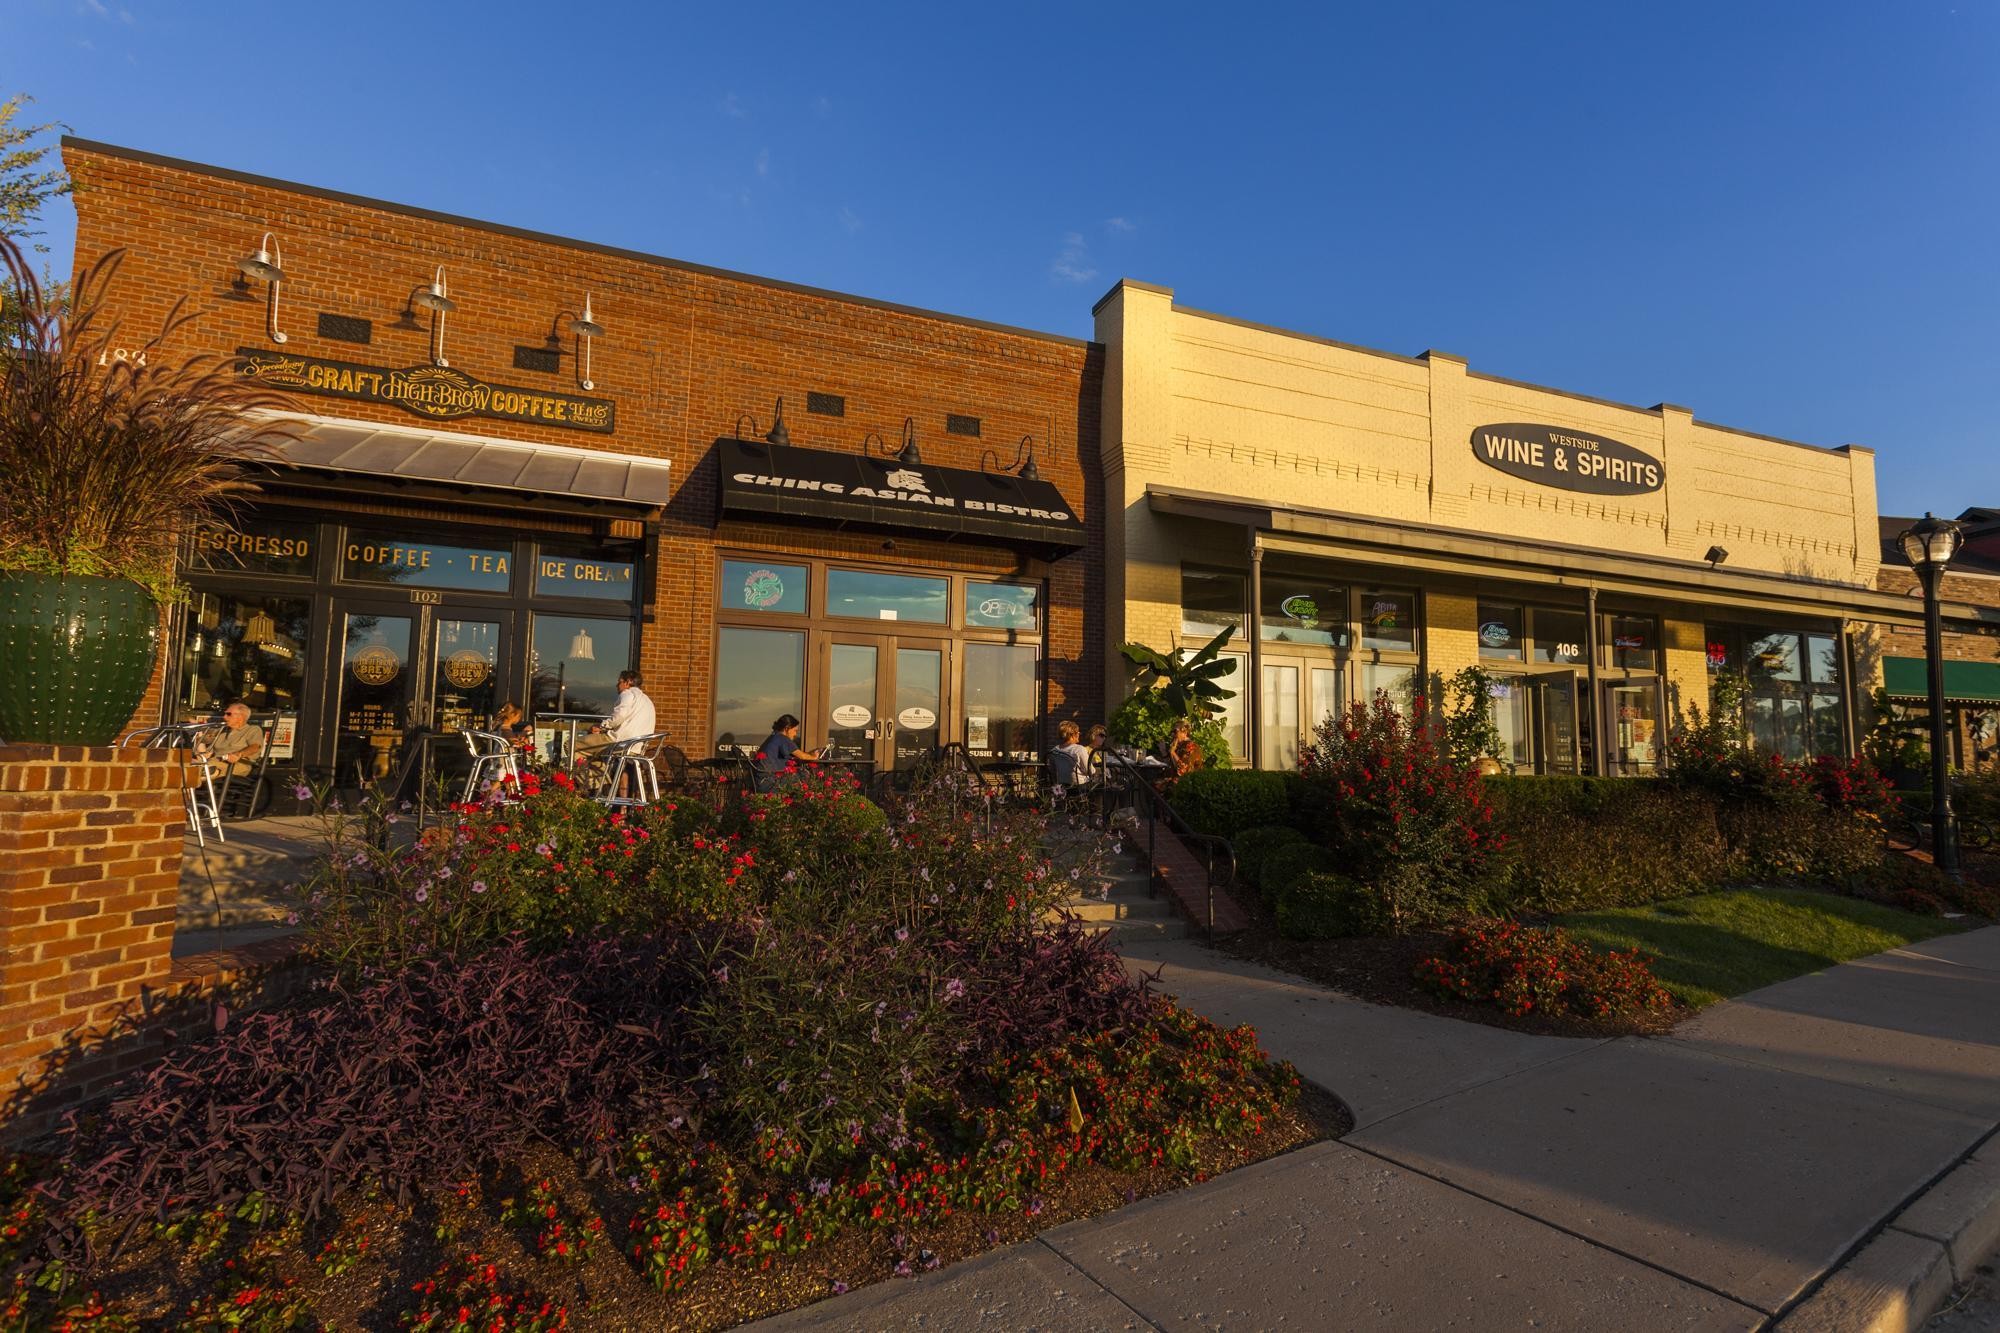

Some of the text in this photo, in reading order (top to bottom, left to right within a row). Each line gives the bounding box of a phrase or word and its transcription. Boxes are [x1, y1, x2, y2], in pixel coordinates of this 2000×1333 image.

[308, 365, 383, 395] CRAFT
[434, 382, 490, 410] BROW
[491, 390, 567, 420] COFFEE
[1549, 433, 1600, 452] WESTSIDE
[1484, 434, 1659, 487] WINE & SPIRITS
[733, 473, 1069, 521] CHING ASIAN BISTRO
[199, 531, 309, 557] ESPRESSO
[347, 544, 508, 574] COFFEE TEA
[541, 561, 567, 578] ICE
[414, 592, 438, 603] 102
[980, 601, 1016, 616] OPEN
[1556, 643, 1579, 657] 106
